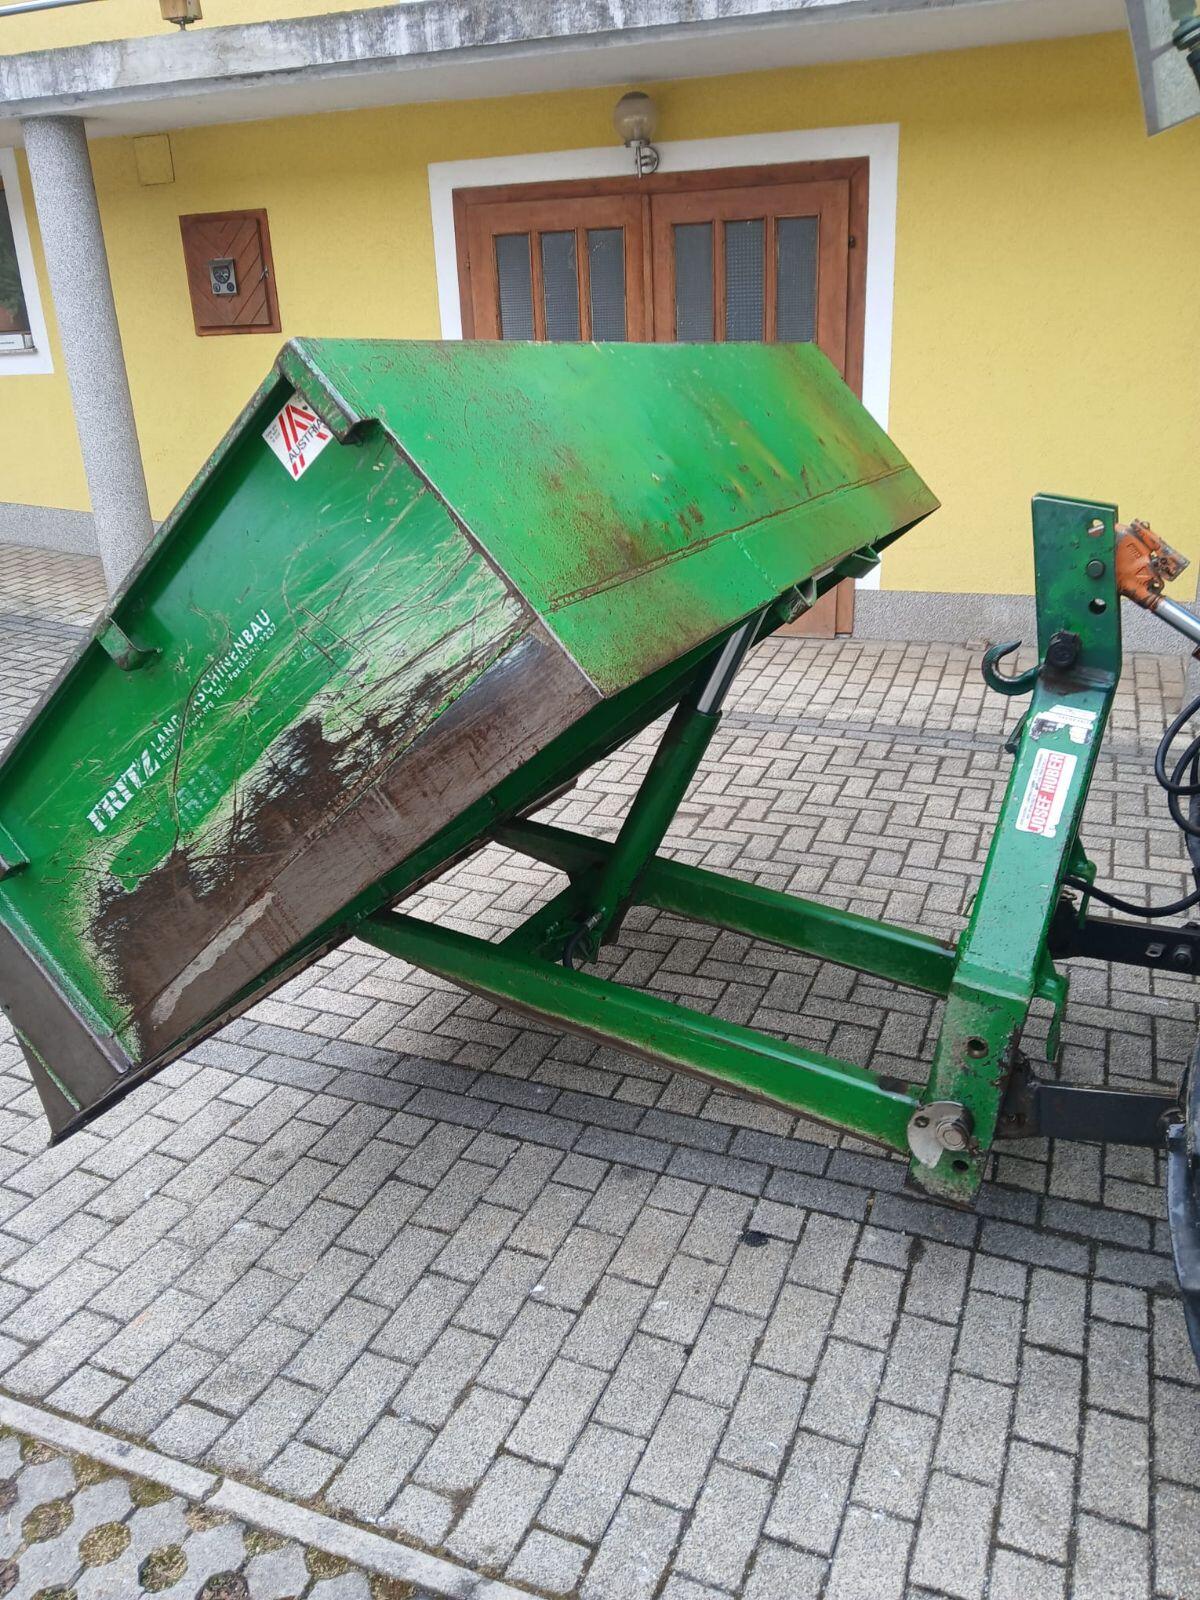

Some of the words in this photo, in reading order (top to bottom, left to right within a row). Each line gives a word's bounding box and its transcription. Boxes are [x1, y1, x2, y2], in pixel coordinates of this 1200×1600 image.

[288, 418, 323, 463] AUSTRIA
[86, 746, 161, 833] FRITZ
[1040, 752, 1065, 794] HUBER
[1028, 792, 1053, 834] JOSEF
